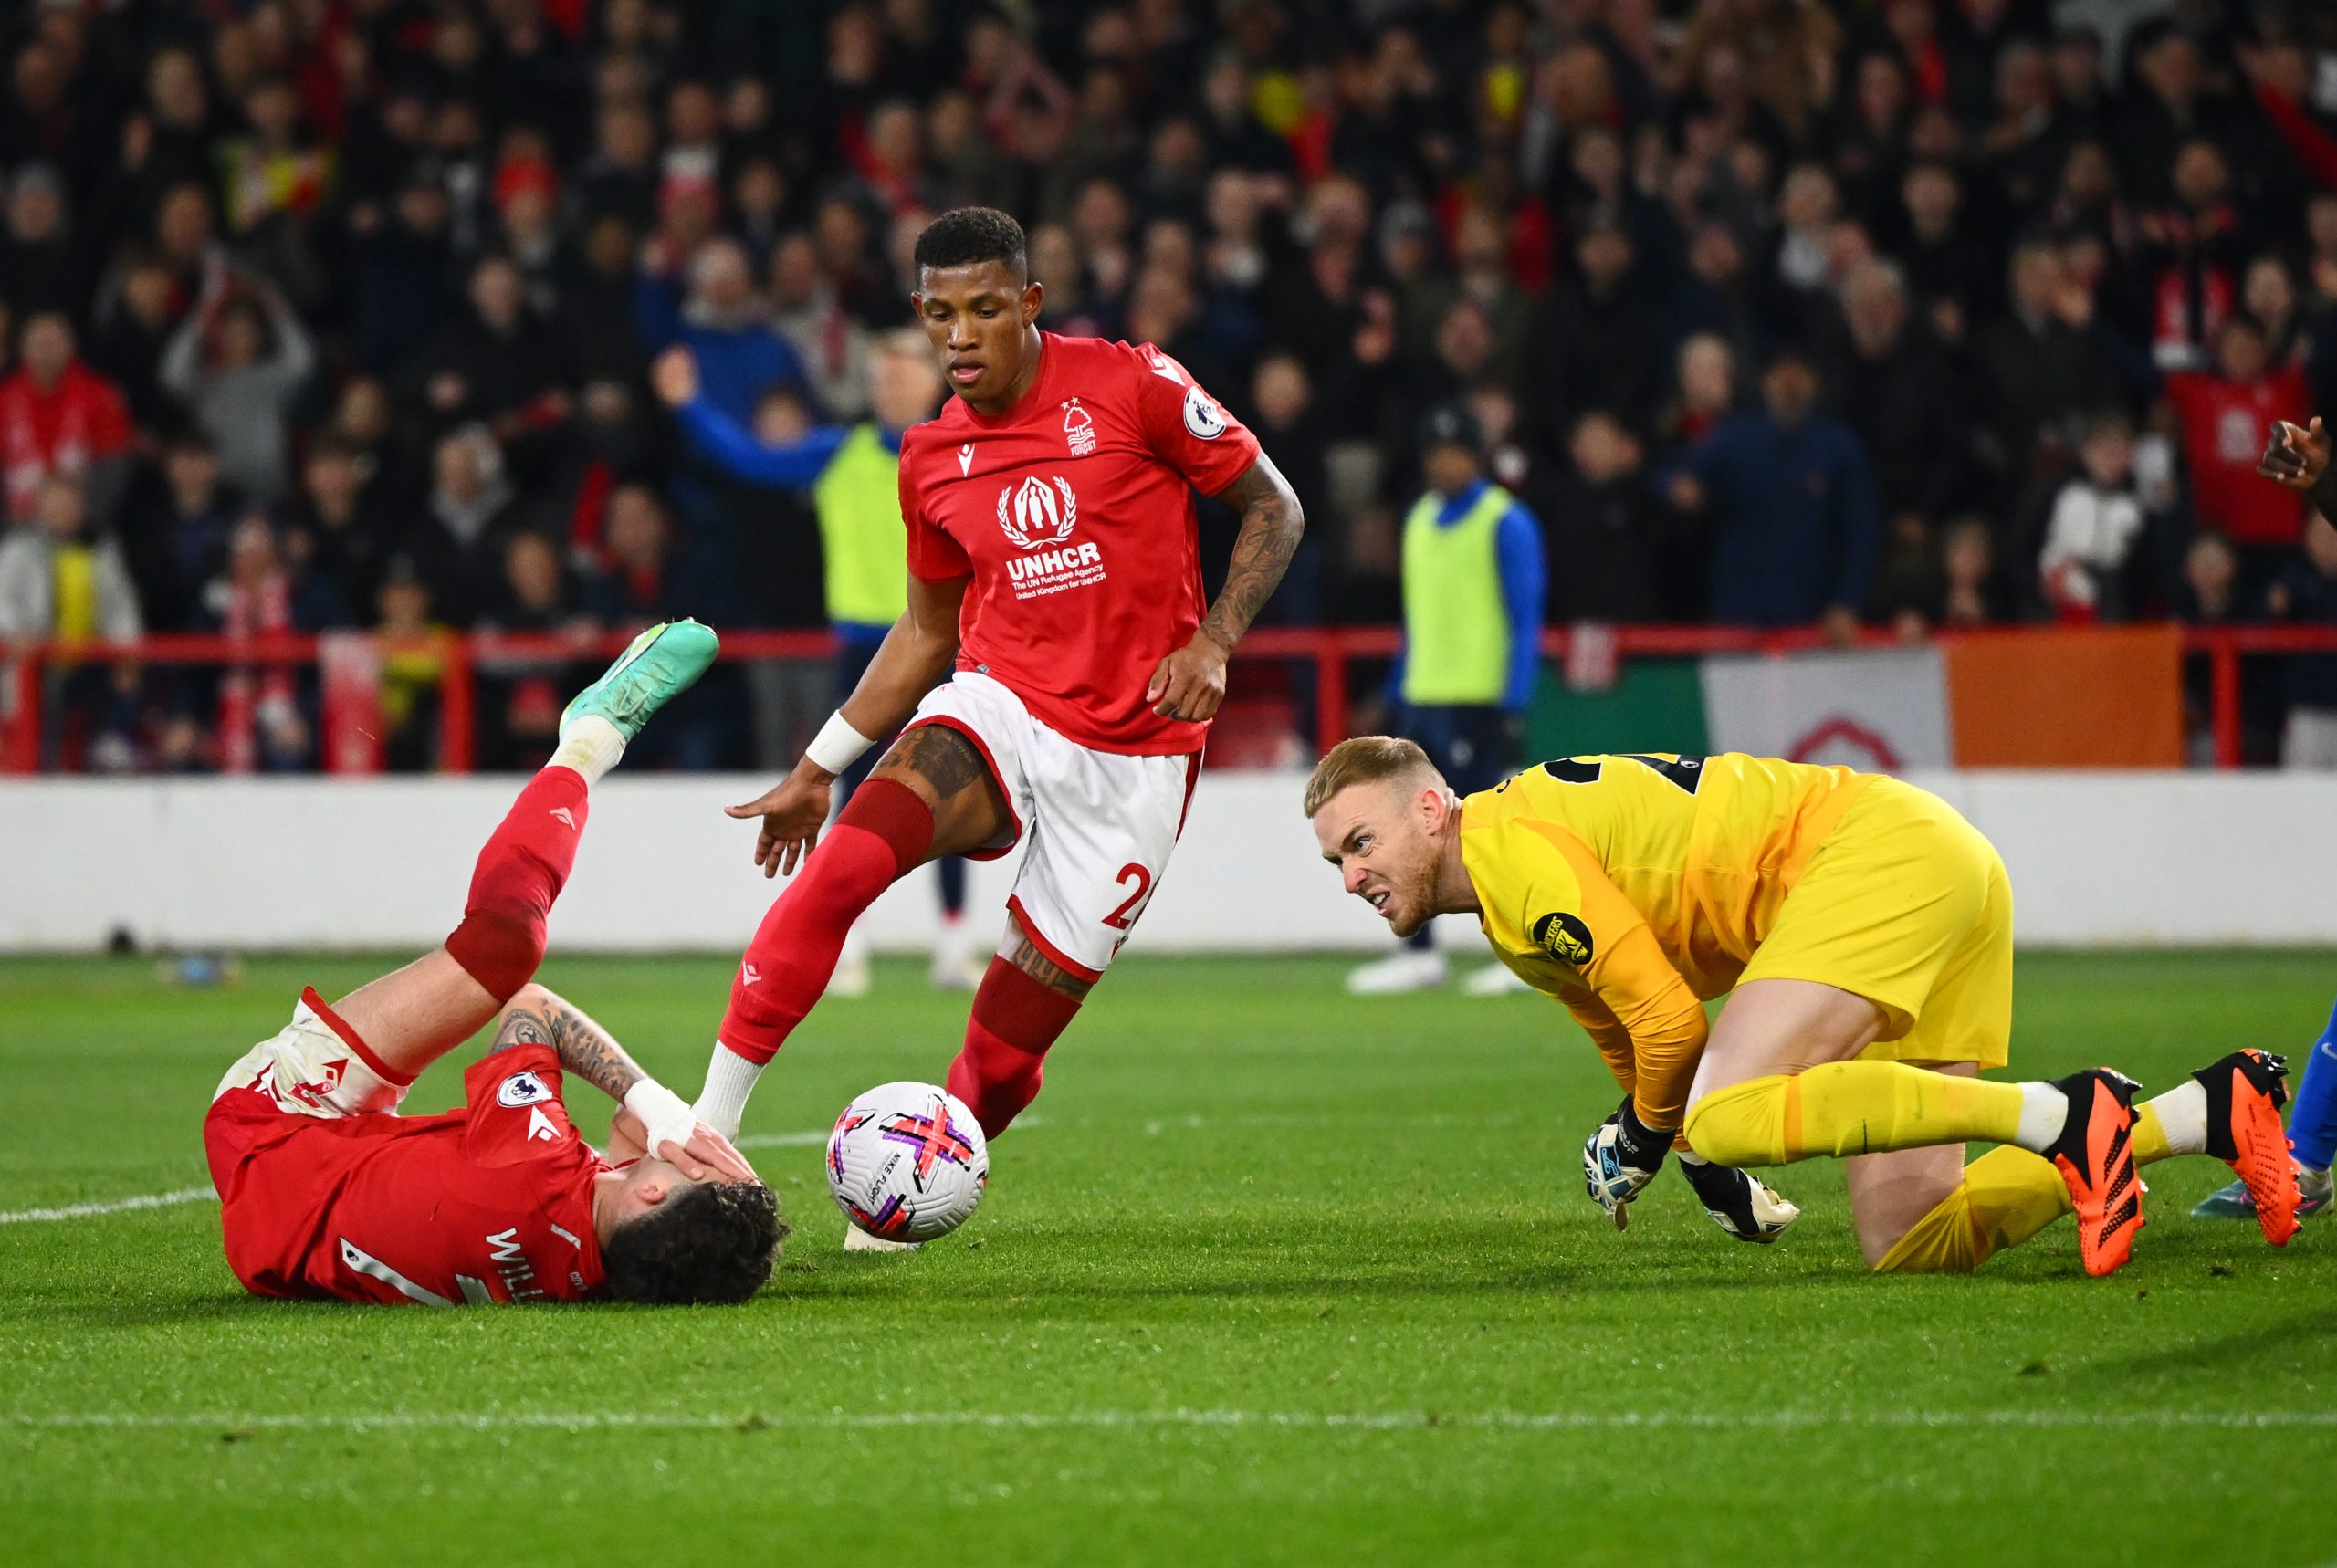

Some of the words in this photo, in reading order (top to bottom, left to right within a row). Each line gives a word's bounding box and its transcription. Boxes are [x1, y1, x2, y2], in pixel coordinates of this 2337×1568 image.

[1005, 541, 1102, 581] UNHCR
[1012, 581, 1027, 591] The
[1026, 579, 1041, 589] UN
[1040, 570, 1074, 585] Refugee
[1074, 563, 1104, 578] Agency
[1015, 590, 1037, 601] United
[1036, 583, 1069, 596] Kingdom
[1069, 580, 1080, 589] for
[1080, 572, 1107, 586] UNHCR
[884, 1151, 901, 1176] NIKE
[867, 1173, 887, 1206] FLIGHT
